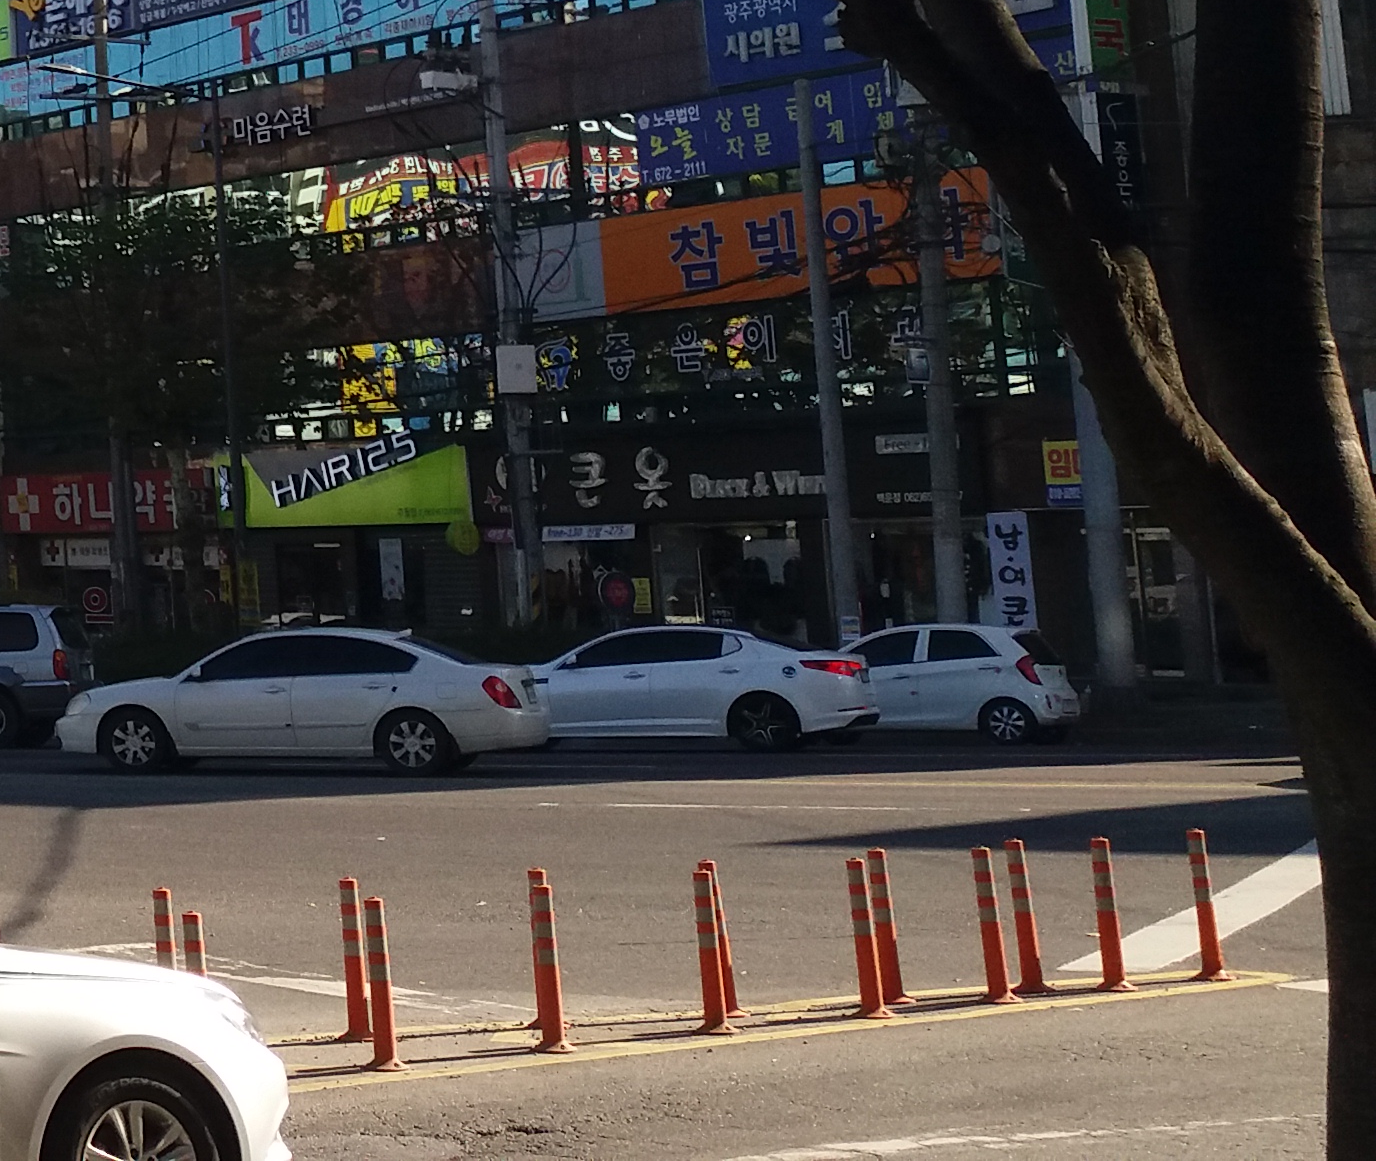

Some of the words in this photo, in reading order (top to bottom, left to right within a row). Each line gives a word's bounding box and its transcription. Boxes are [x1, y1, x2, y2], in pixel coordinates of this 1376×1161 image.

[724, 21, 803, 64] 시의원
[232, 103, 313, 147] 마음수련
[652, 103, 700, 128] 노무법인
[649, 126, 698, 161] 오늘
